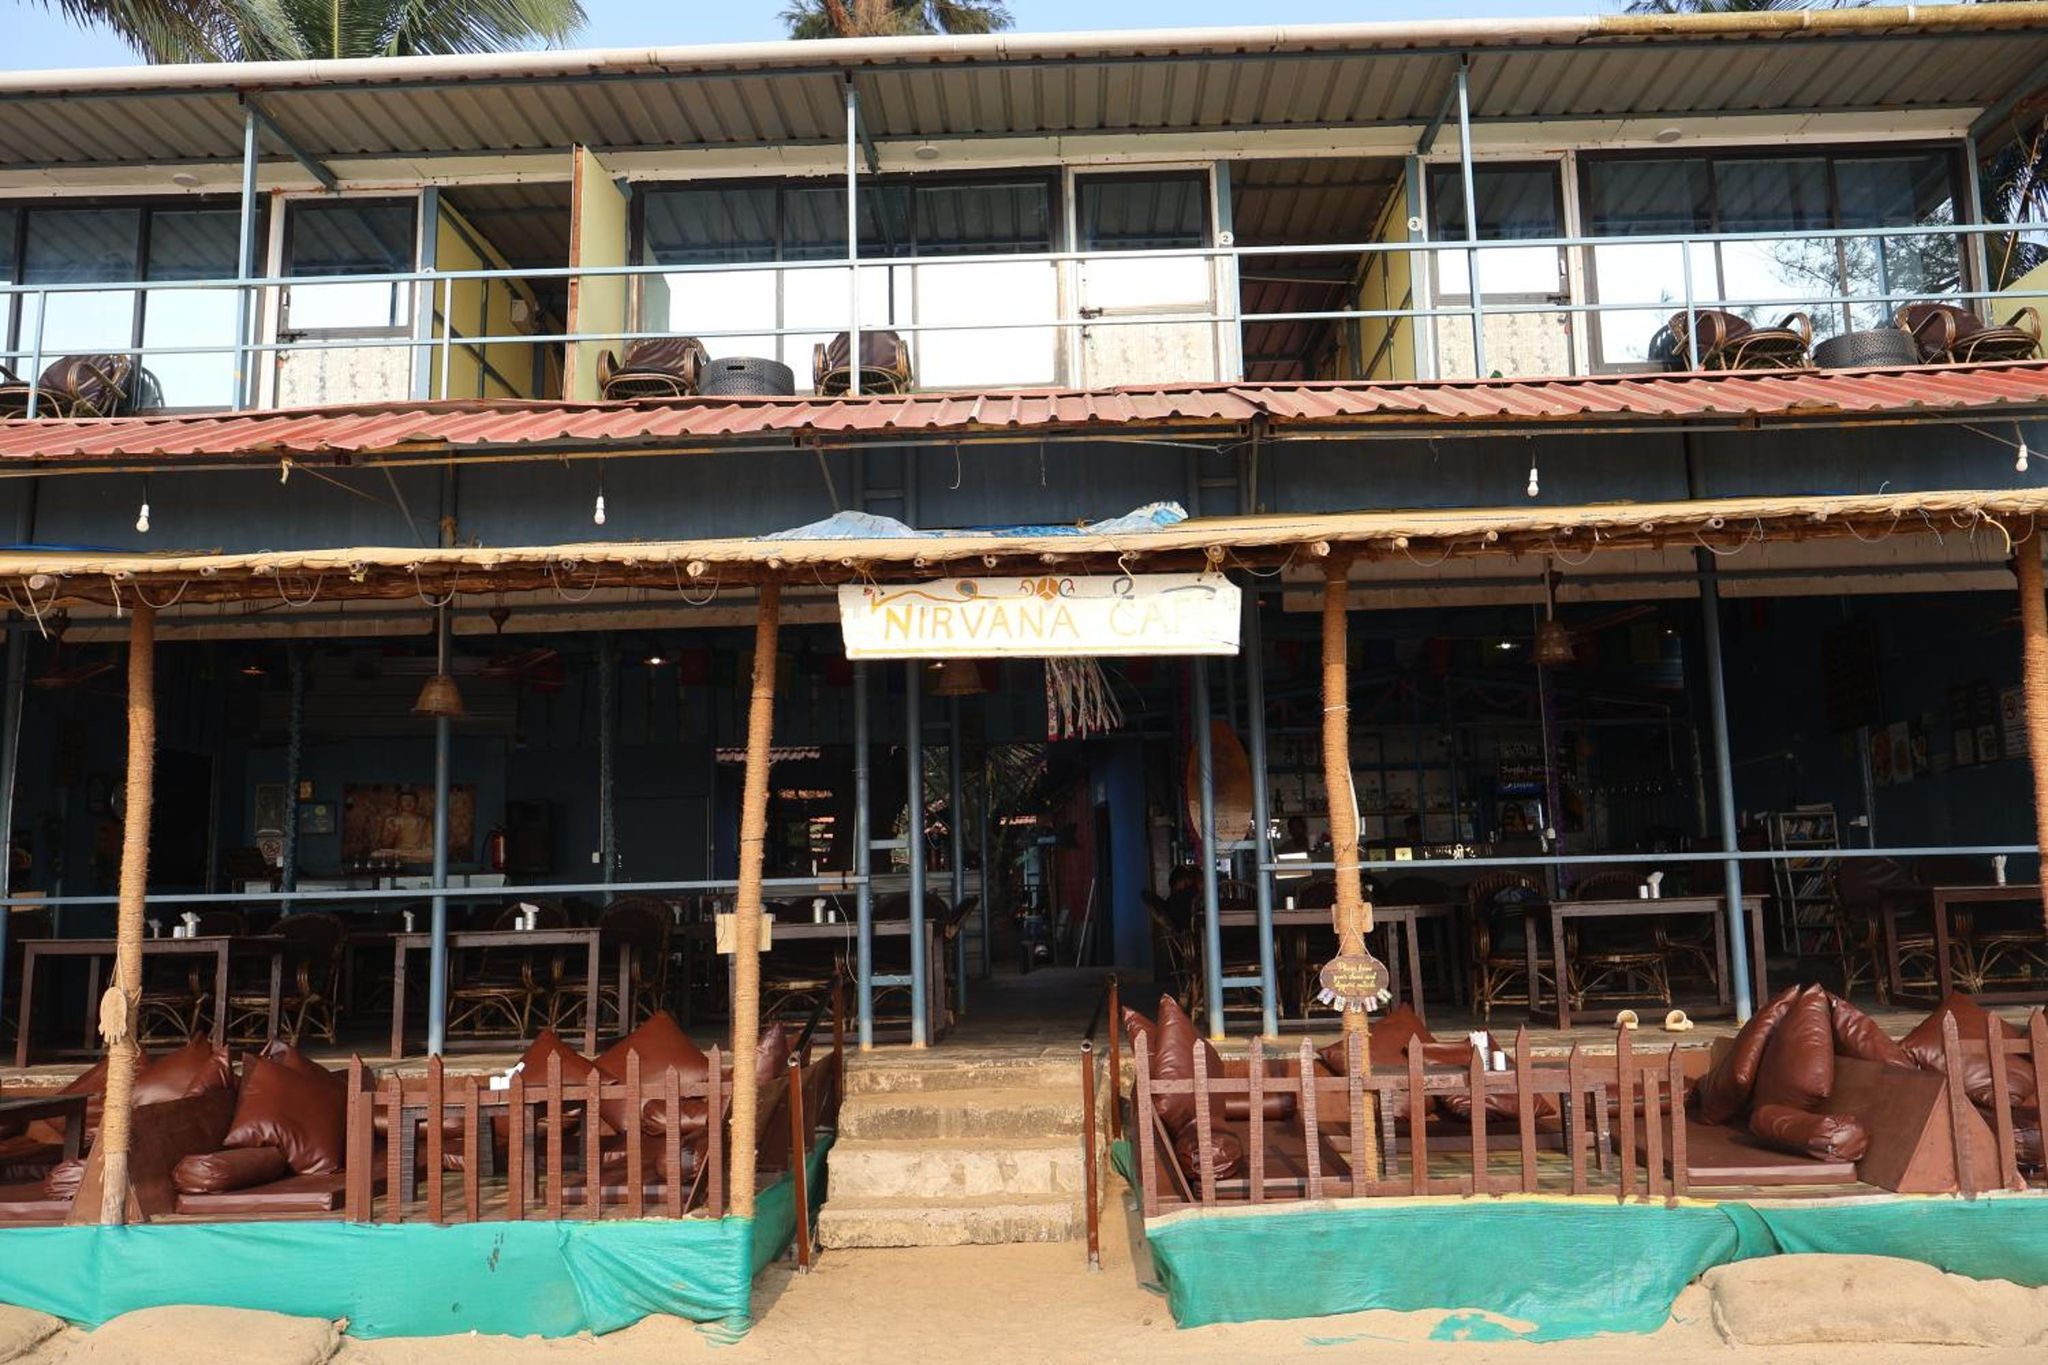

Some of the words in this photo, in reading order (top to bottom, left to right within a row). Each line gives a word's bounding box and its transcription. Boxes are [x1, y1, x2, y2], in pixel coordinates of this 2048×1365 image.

[1222, 234, 1229, 243] 2
[884, 602, 1080, 641] NIRVANA
[1108, 597, 1196, 638] CAF
